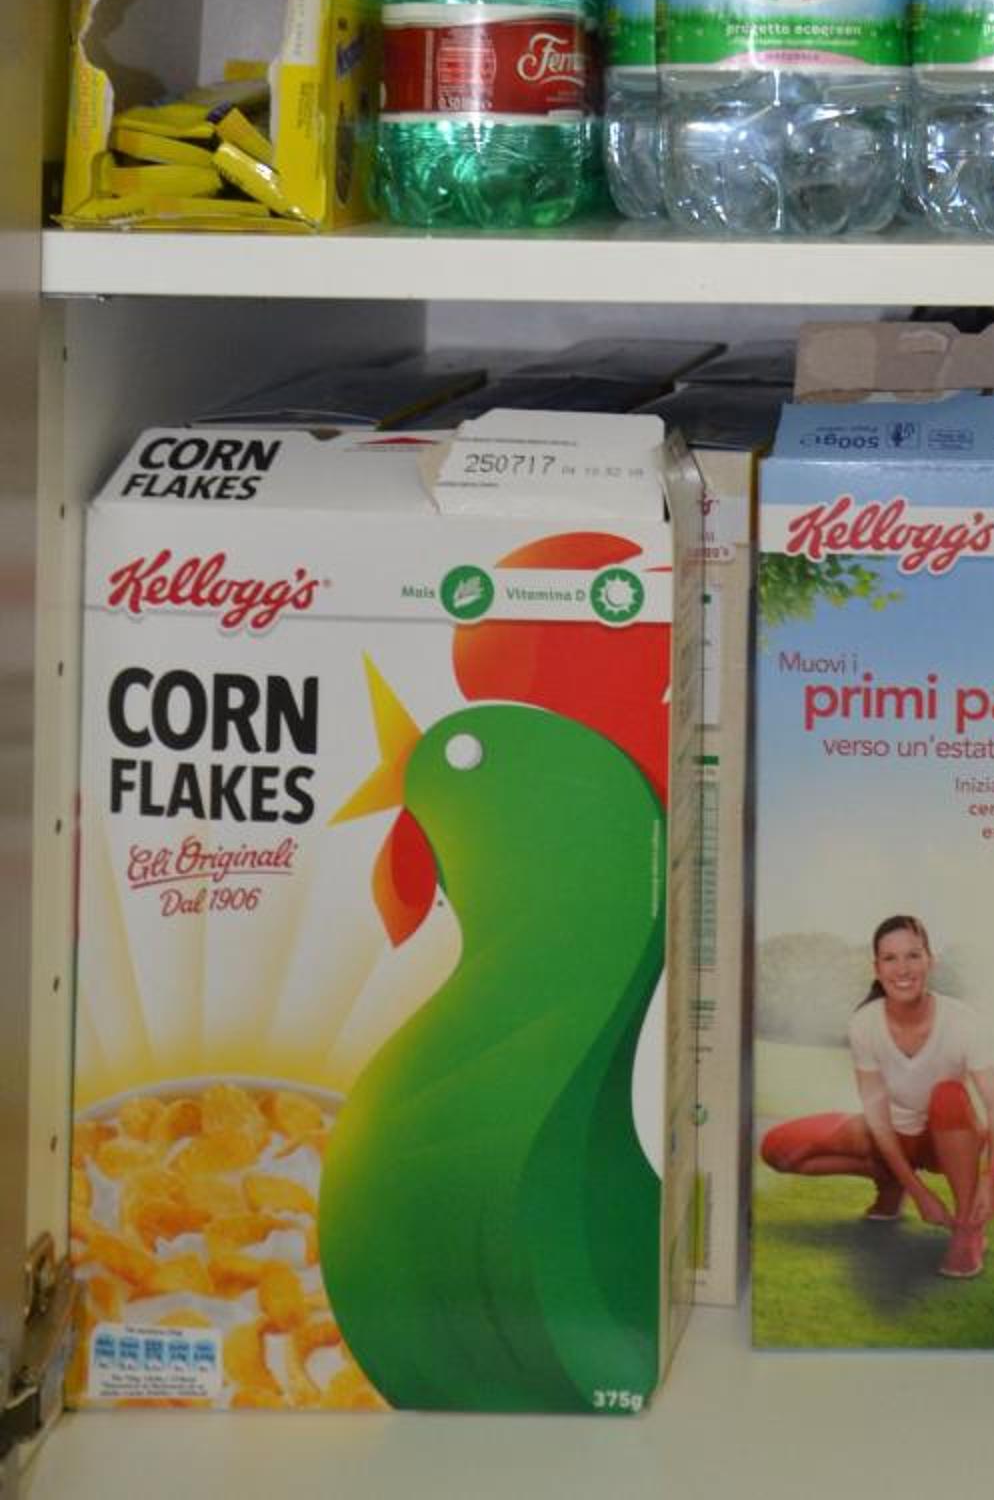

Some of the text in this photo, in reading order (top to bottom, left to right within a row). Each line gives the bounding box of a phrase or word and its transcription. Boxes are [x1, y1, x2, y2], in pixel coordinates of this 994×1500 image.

[138, 436, 283, 472] CORN
[464, 453, 557, 475] 250717
[121, 473, 263, 501] FLAKES
[108, 548, 320, 630] Kellogg's
[506, 586, 586, 601] Vitamina D
[779, 652, 858, 674] Muovi i
[108, 666, 319, 756] CORN
[804, 672, 938, 732] primi
[822, 737, 890, 757] verso
[109, 757, 316, 826] FLAKES
[127, 835, 299, 883] Gli Originali
[160, 886, 261, 917] Dal 1906
[593, 1389, 645, 1411] 375g
